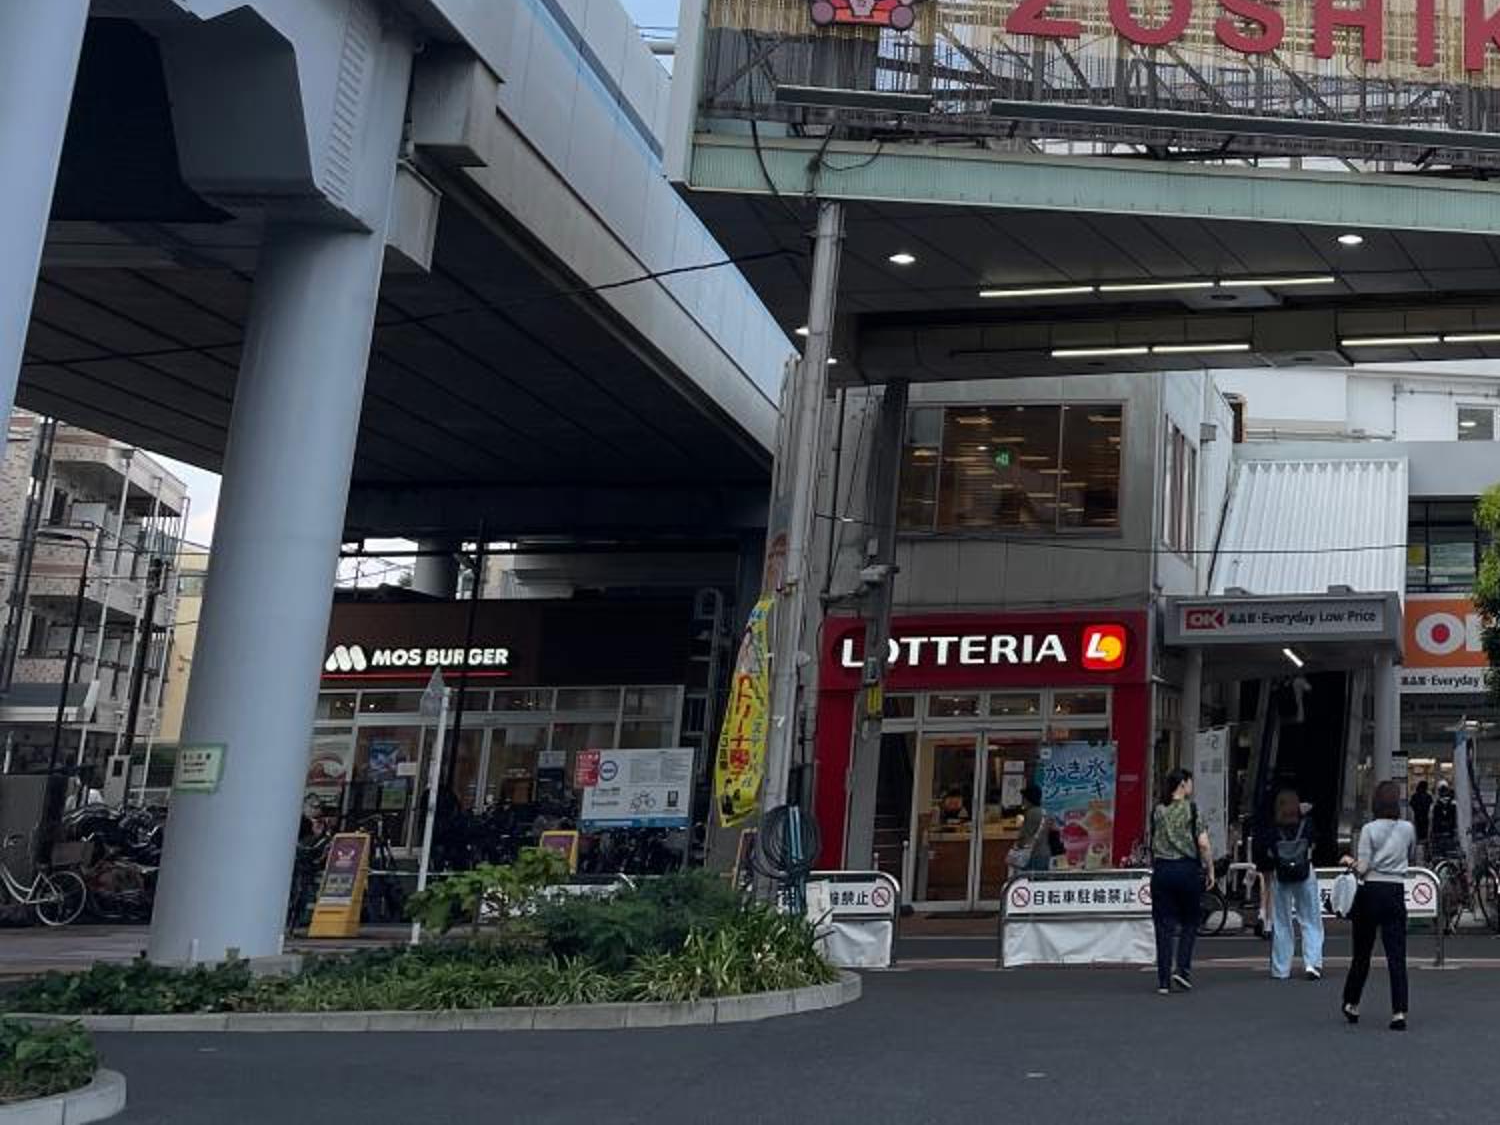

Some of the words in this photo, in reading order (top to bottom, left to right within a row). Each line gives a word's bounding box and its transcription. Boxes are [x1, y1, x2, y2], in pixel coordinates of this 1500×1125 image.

[1319, 610, 1343, 623] Low
[1347, 609, 1376, 623] Price
[371, 649, 421, 667] MOS
[424, 648, 509, 666] BURGER
[1033, 888, 1136, 905] 自転車駐輪禁止
